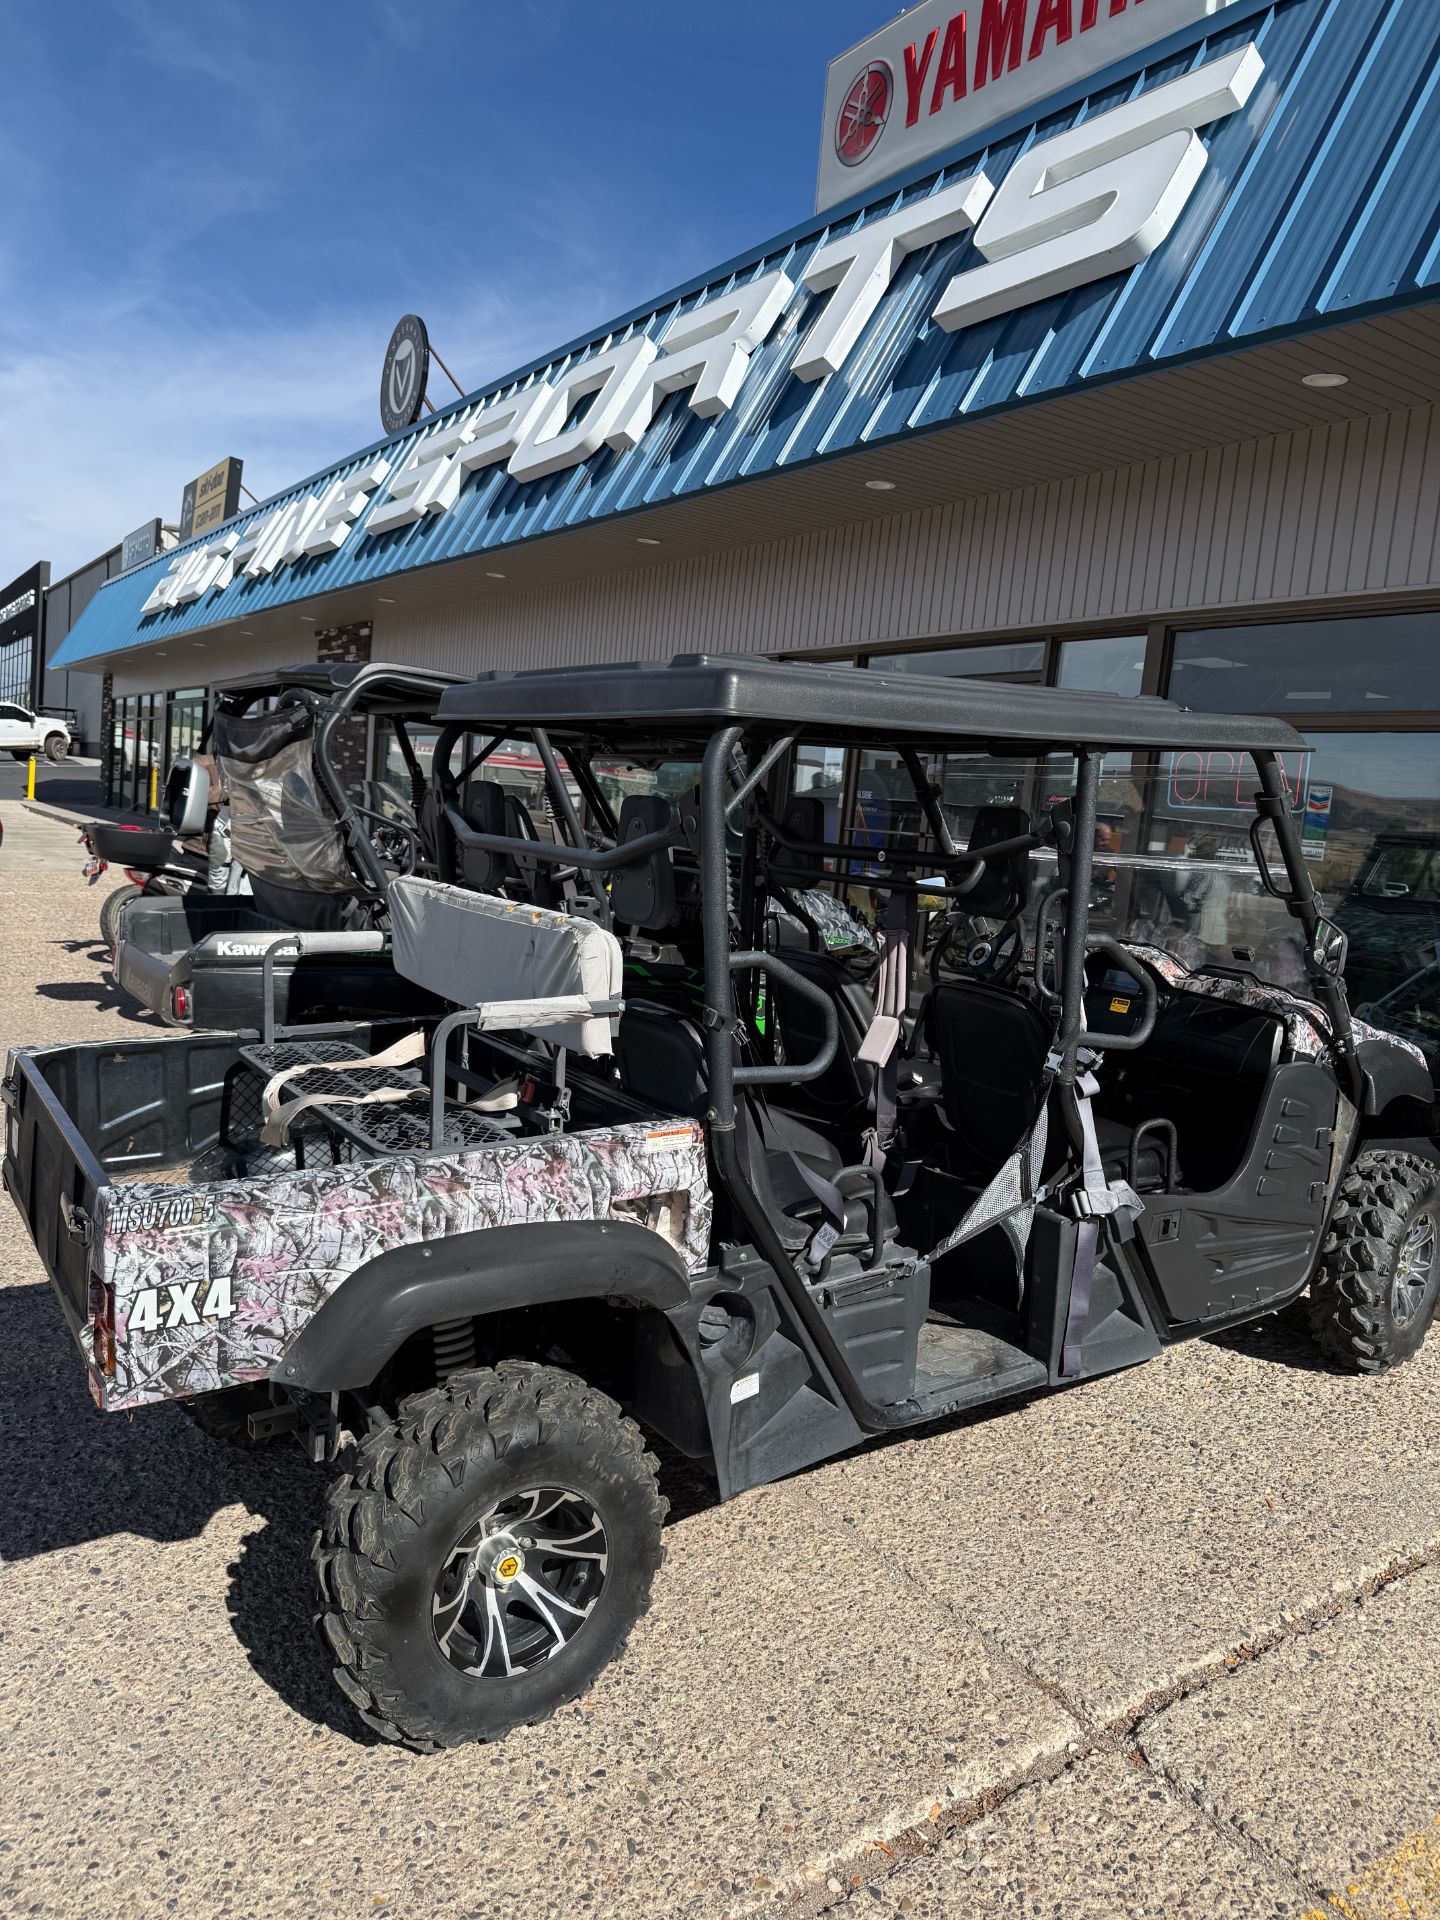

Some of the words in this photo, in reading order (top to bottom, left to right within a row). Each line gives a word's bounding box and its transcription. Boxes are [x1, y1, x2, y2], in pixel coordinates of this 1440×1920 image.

[904, 0, 1146, 128] YAMA
[365, 41, 1266, 536] SPORTS
[110, 1195, 216, 1235] MSU700-5
[127, 1276, 237, 1333] 4X4
